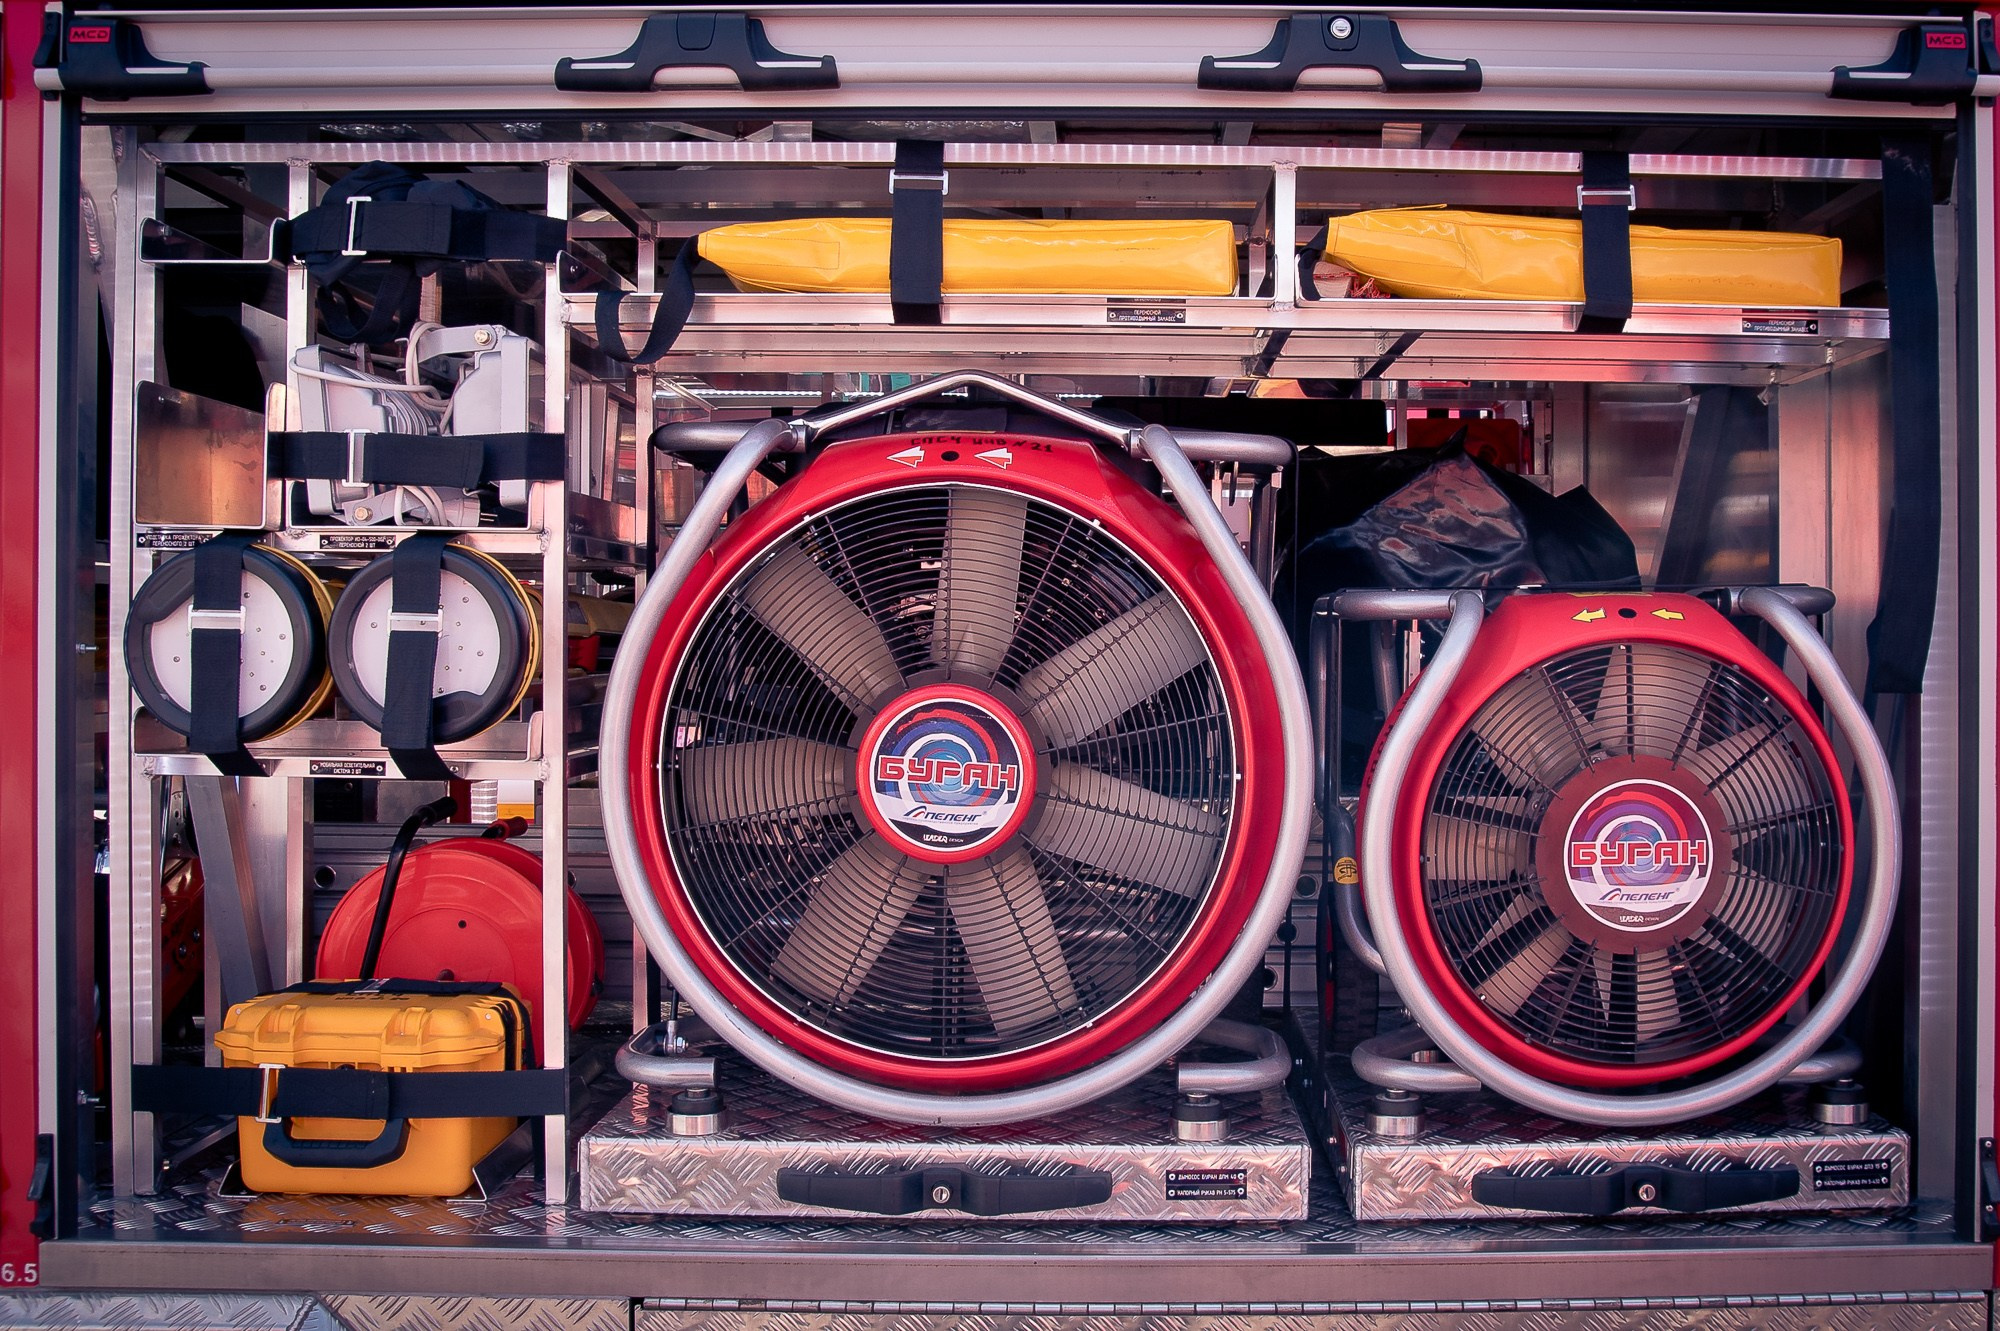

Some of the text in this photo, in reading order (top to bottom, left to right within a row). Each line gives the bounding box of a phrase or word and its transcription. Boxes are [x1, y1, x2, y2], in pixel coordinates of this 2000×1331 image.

[72, 30, 109, 39] MCD
[1929, 35, 1964, 45] MCD
[878, 755, 1018, 791] БУРАН
[1571, 840, 1707, 868] БУРАН
[1, 1263, 38, 1283] 6.5
